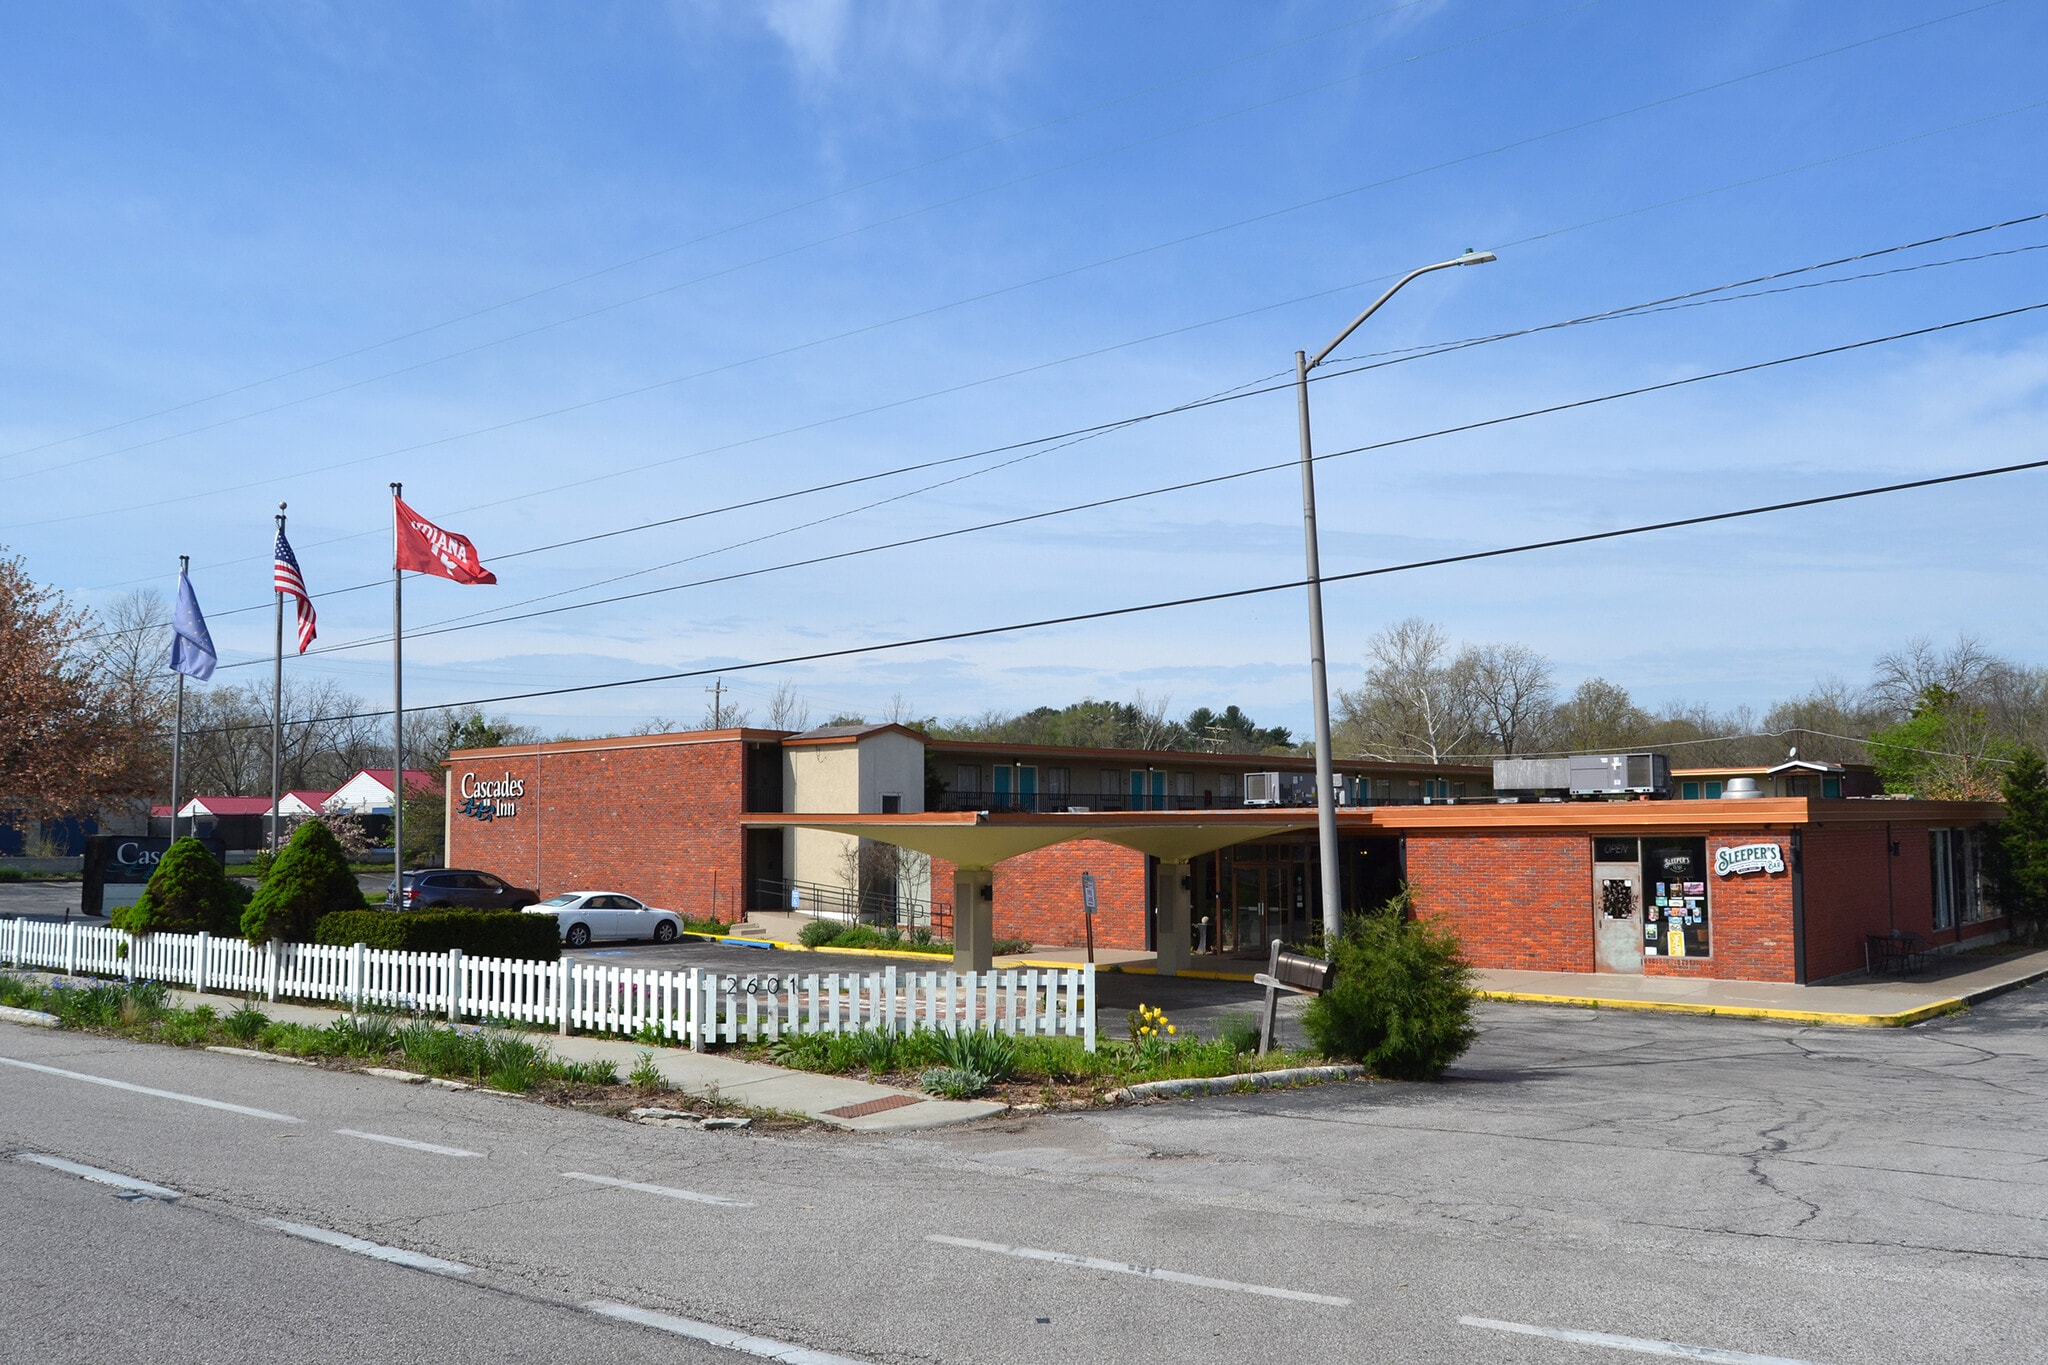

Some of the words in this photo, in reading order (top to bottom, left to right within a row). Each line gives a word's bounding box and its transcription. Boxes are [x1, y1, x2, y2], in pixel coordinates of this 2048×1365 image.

[461, 772, 524, 799] Cascades
[496, 799, 516, 817] Inn
[1604, 843, 1629, 854] OPEN
[1718, 846, 1777, 871] SLEEPER'S
[727, 977, 797, 995] 2601
